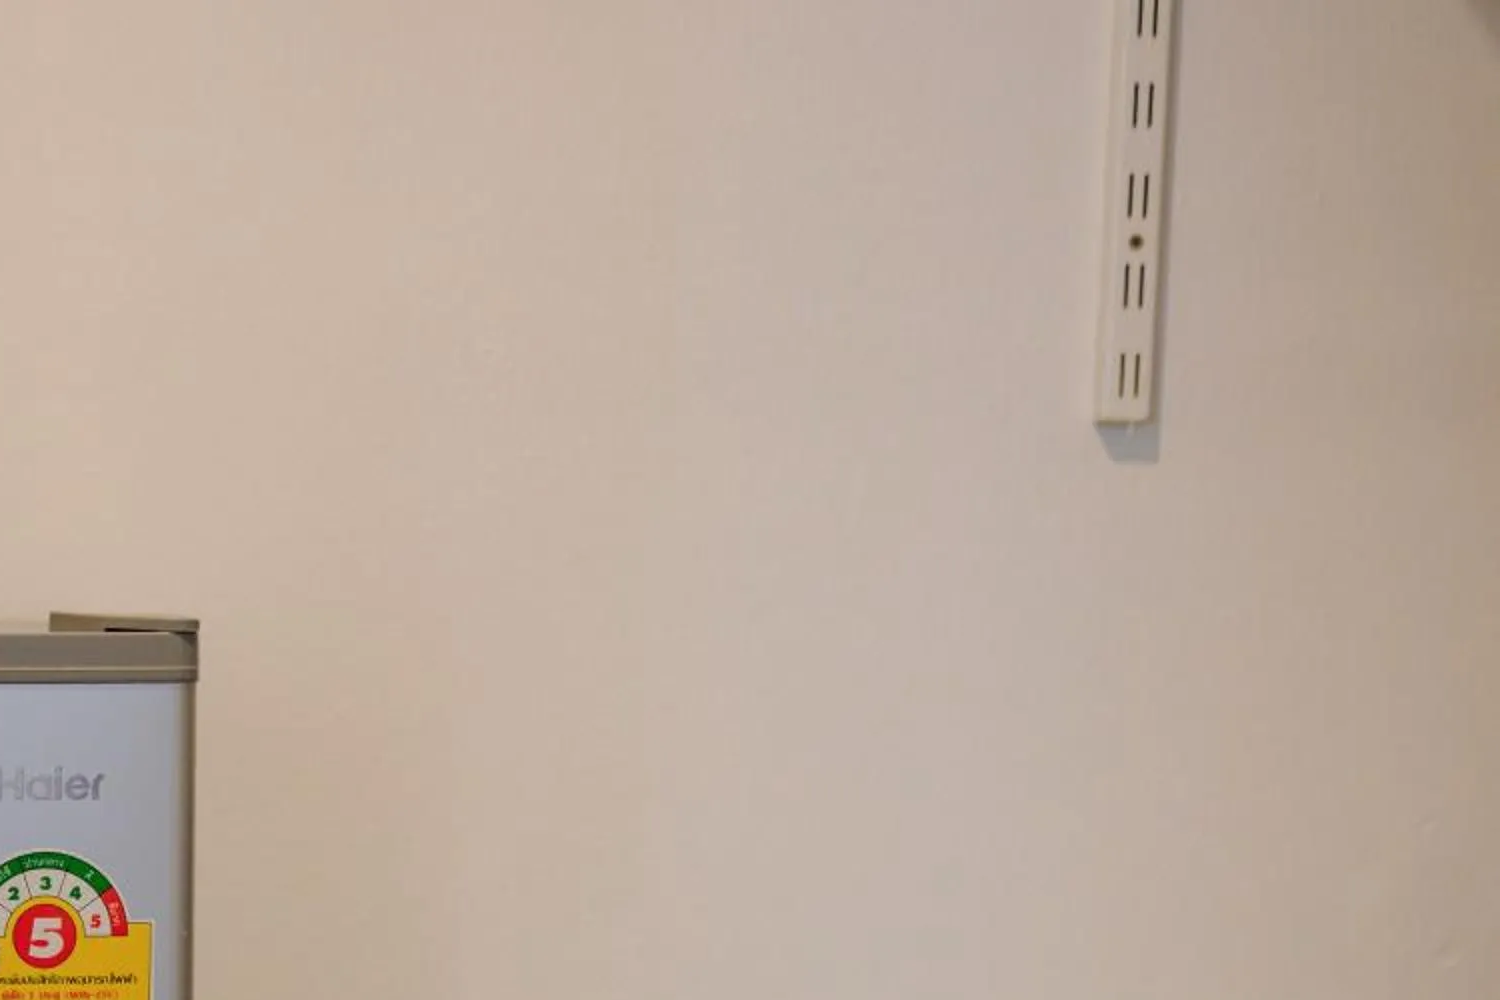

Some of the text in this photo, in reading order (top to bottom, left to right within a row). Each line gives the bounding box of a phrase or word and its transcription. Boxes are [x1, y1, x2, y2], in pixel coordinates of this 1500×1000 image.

[7, 887, 20, 901] 2
[39, 876, 52, 890] 3
[69, 886, 82, 900] 4
[90, 914, 101, 928] 5
[28, 917, 64, 959] 5
